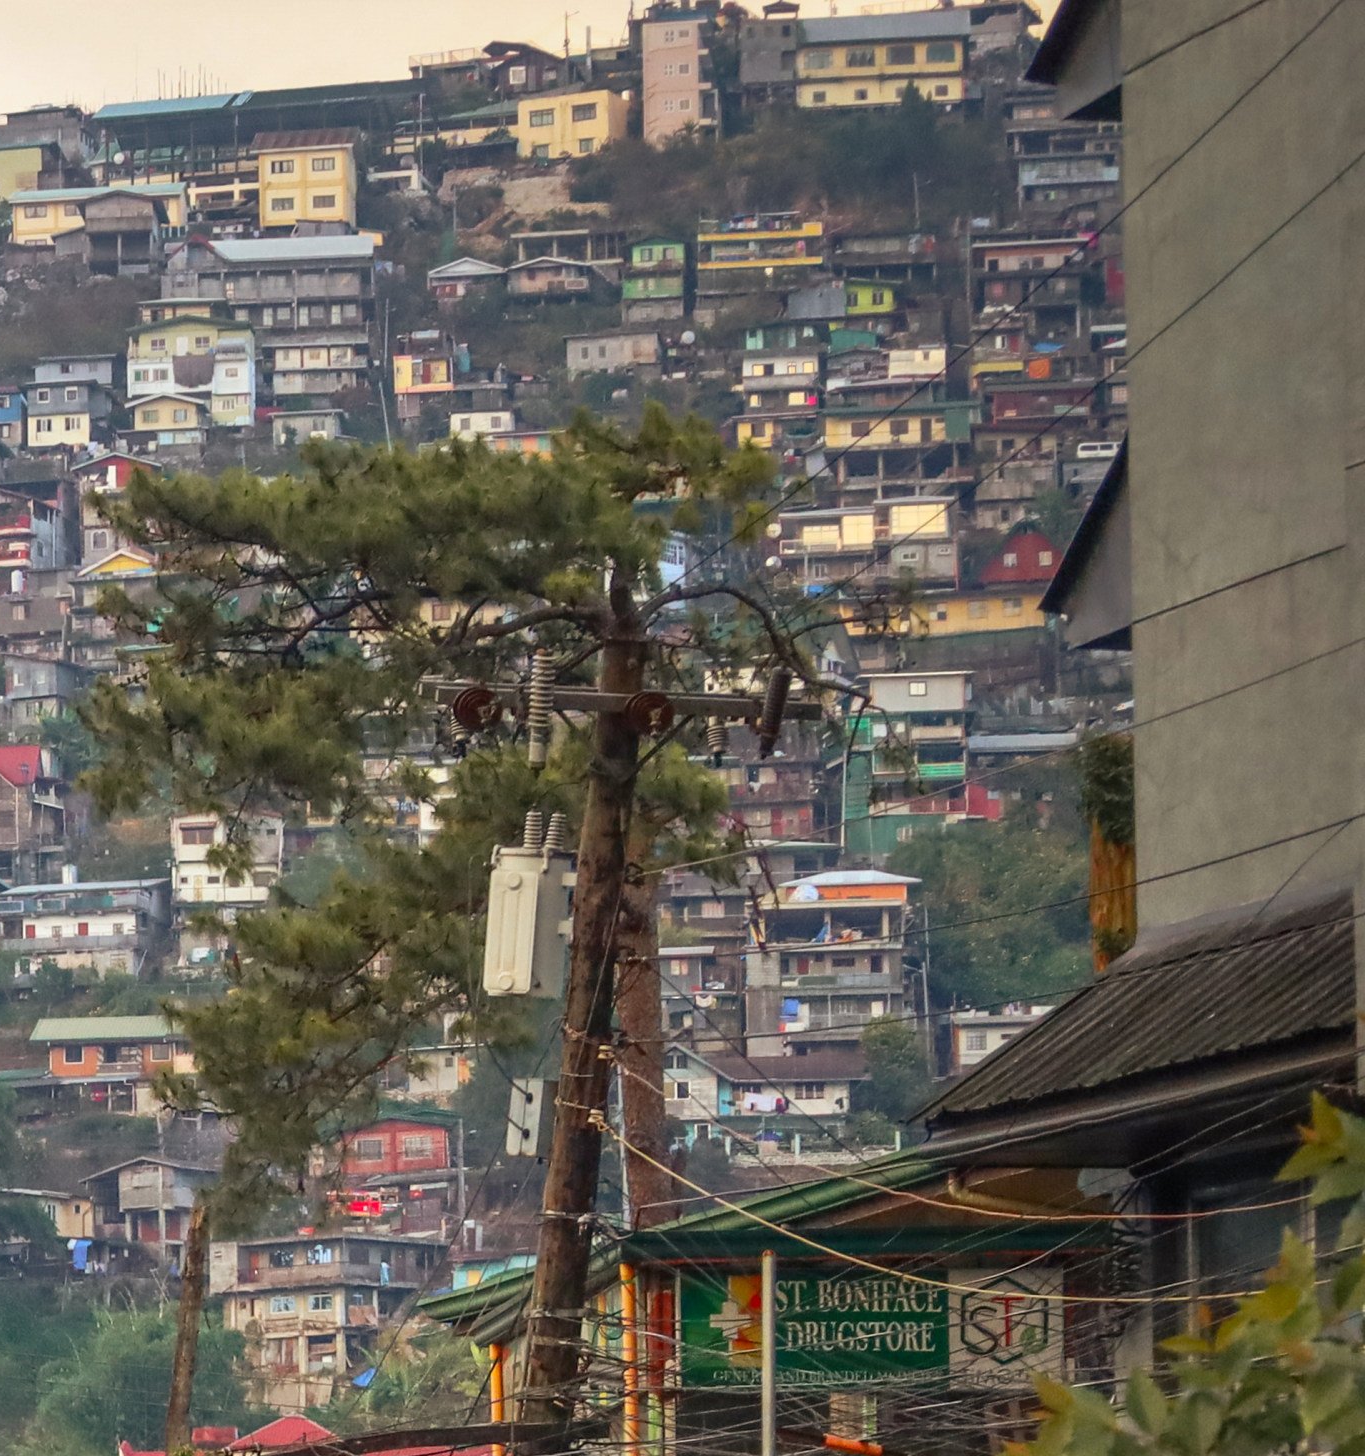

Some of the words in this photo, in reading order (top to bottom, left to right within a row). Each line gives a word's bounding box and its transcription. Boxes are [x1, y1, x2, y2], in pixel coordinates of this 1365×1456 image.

[775, 1280, 810, 1313] ST.
[818, 1278, 943, 1313] BONIFACE
[785, 1321, 936, 1353] DRUGSTORE
